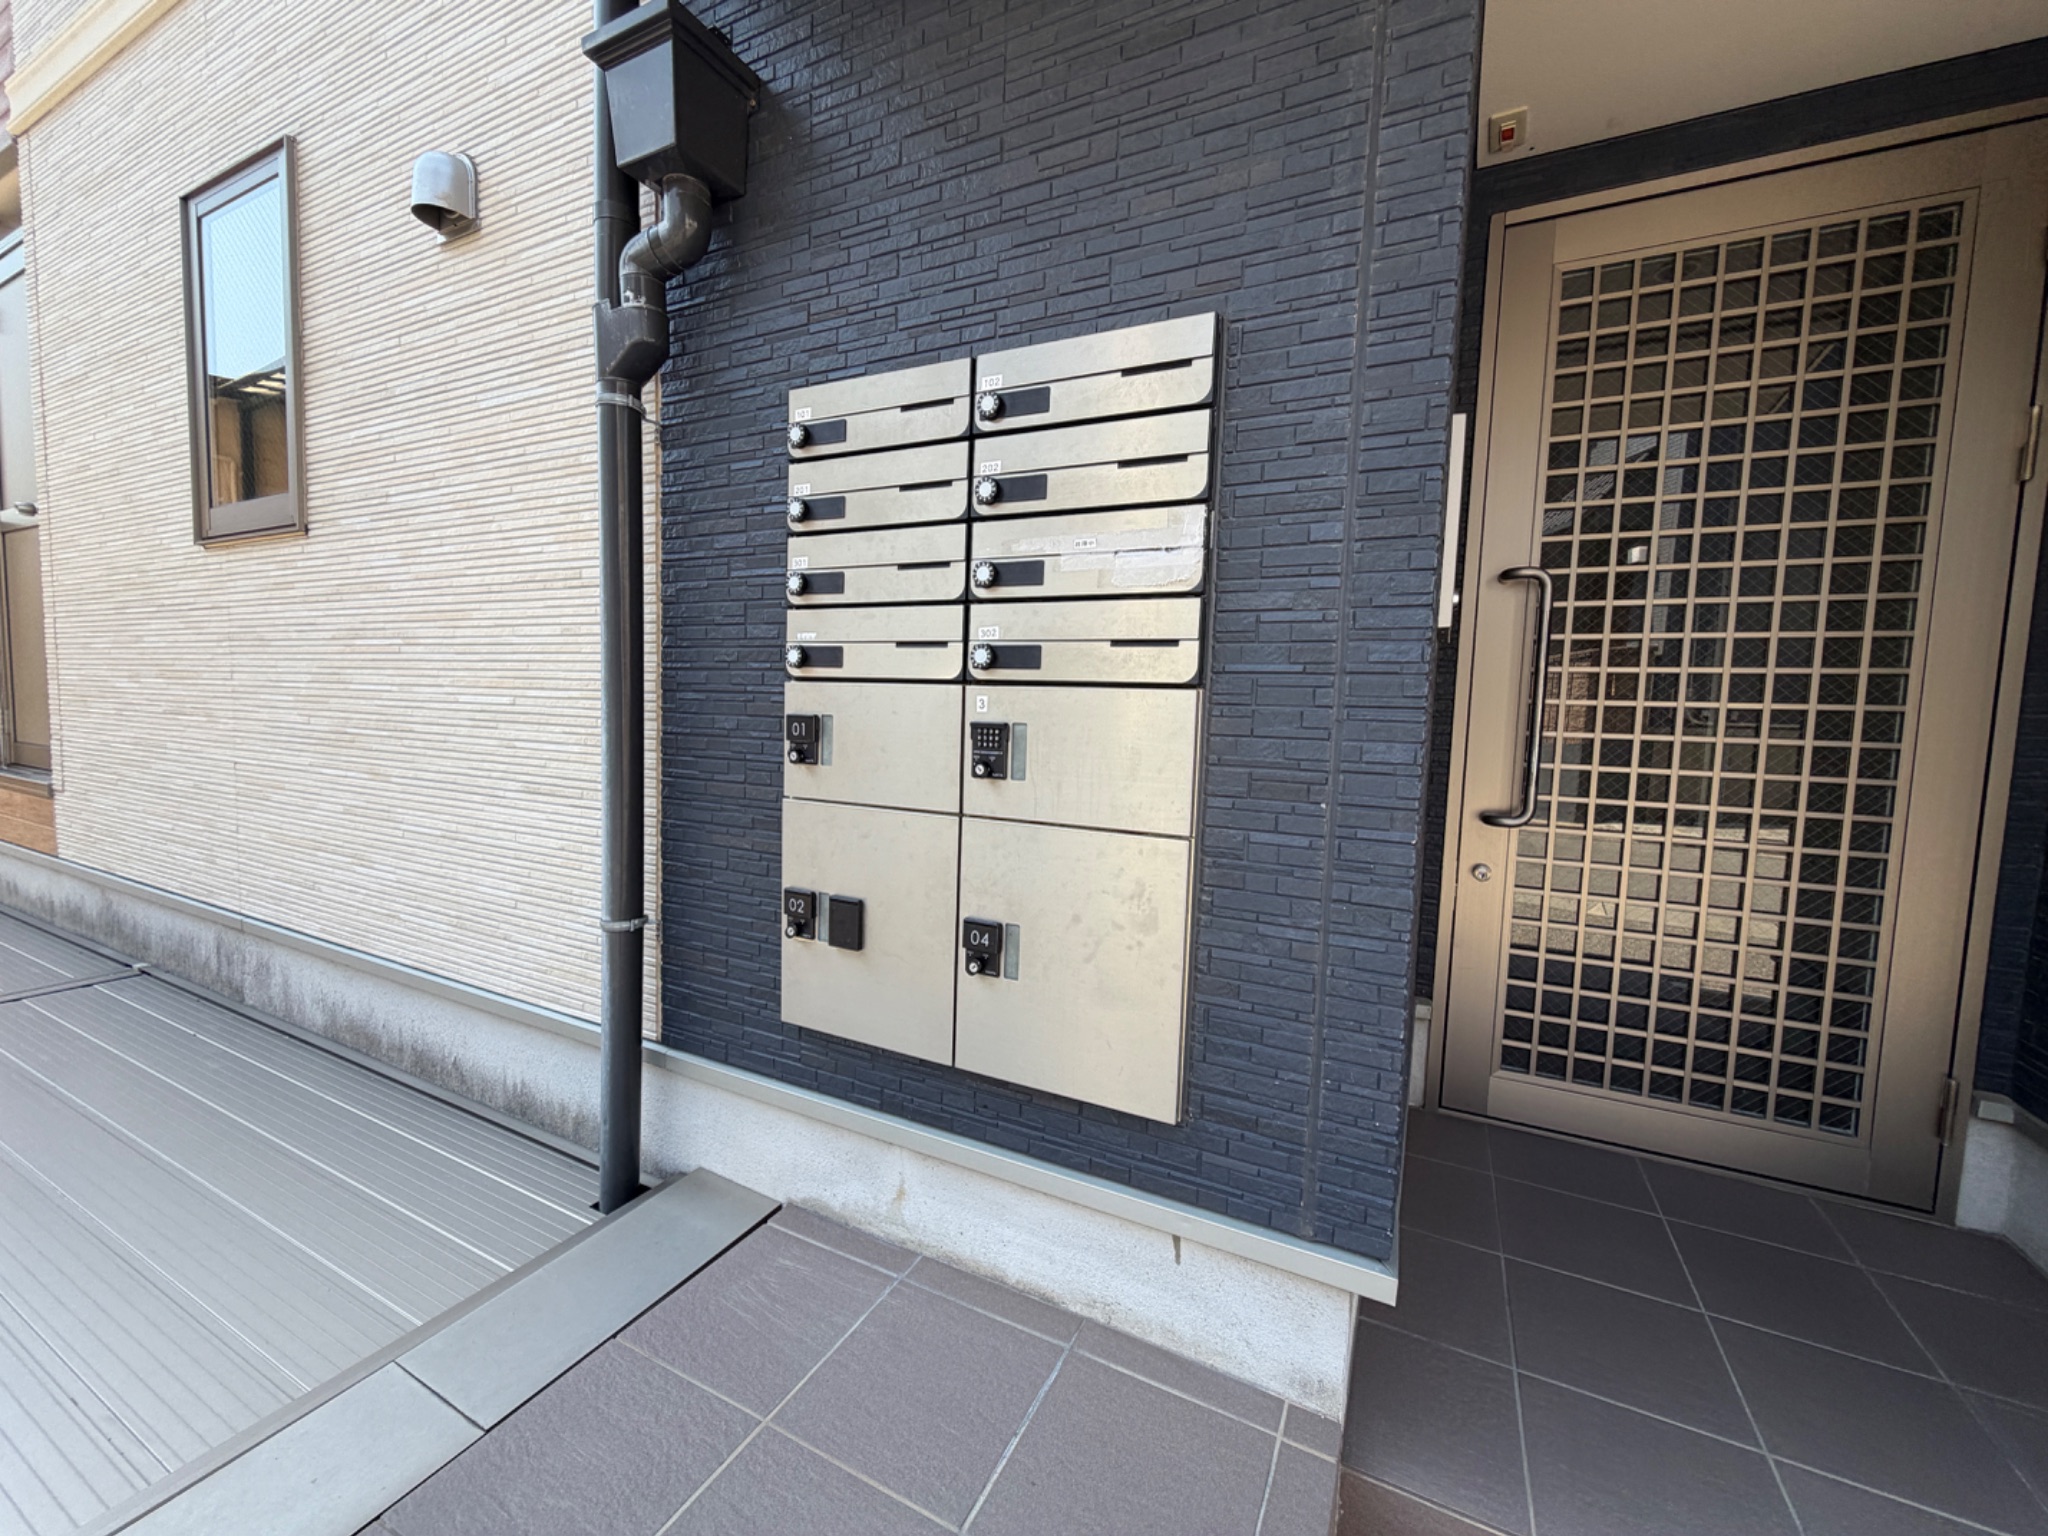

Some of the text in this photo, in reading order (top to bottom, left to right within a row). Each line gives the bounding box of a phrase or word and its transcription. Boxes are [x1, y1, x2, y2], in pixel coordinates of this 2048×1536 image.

[984, 376, 1001, 388] 102
[981, 462, 999, 473] 202
[980, 627, 997, 638] 302
[979, 698, 986, 710] 3
[791, 722, 806, 737] 01
[788, 898, 805, 914] 02
[970, 930, 989, 947] 04
